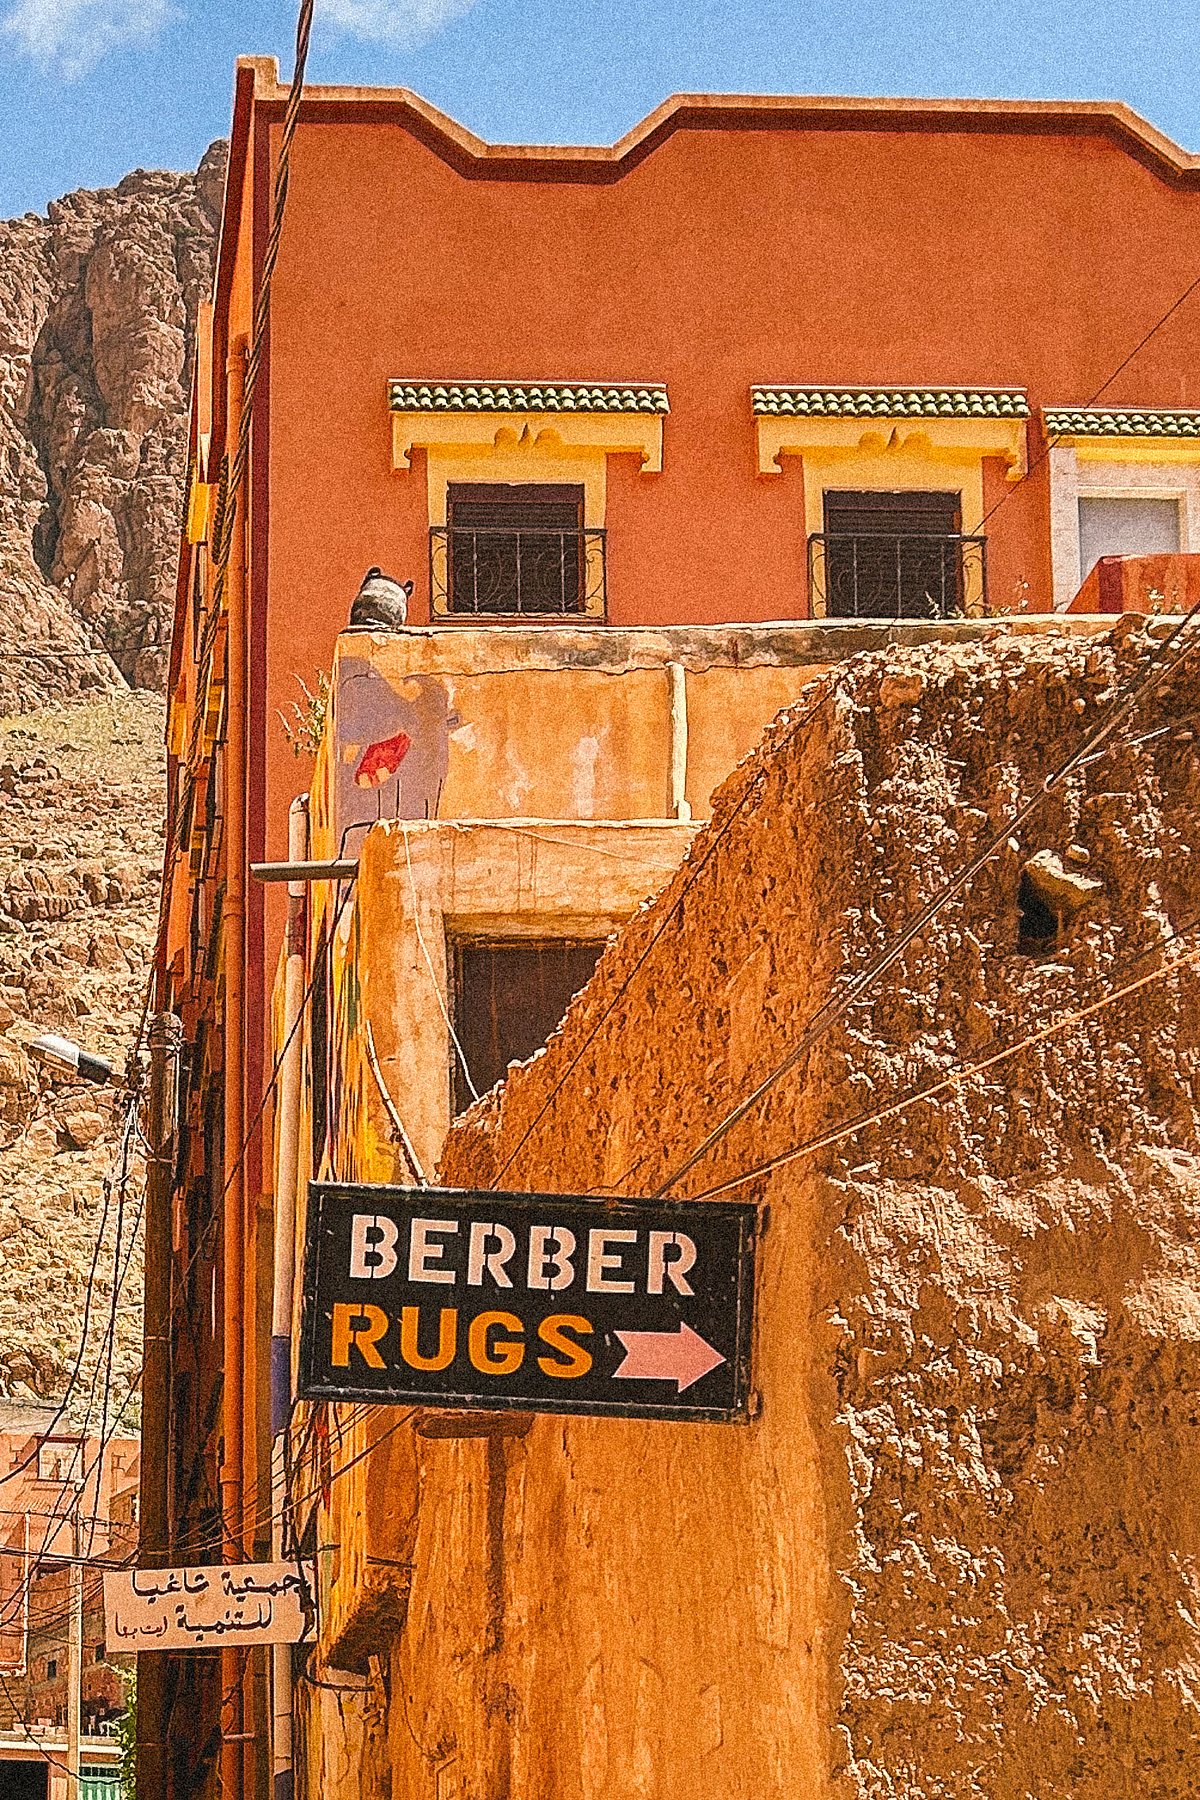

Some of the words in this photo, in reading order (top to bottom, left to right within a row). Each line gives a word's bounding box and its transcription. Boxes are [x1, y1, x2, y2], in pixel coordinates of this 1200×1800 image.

[349, 1214, 697, 1296] BERBER
[331, 1303, 595, 1379] RUGS
[220, 1571, 302, 1603] جمعية
[175, 1597, 273, 1642] للتنمية
